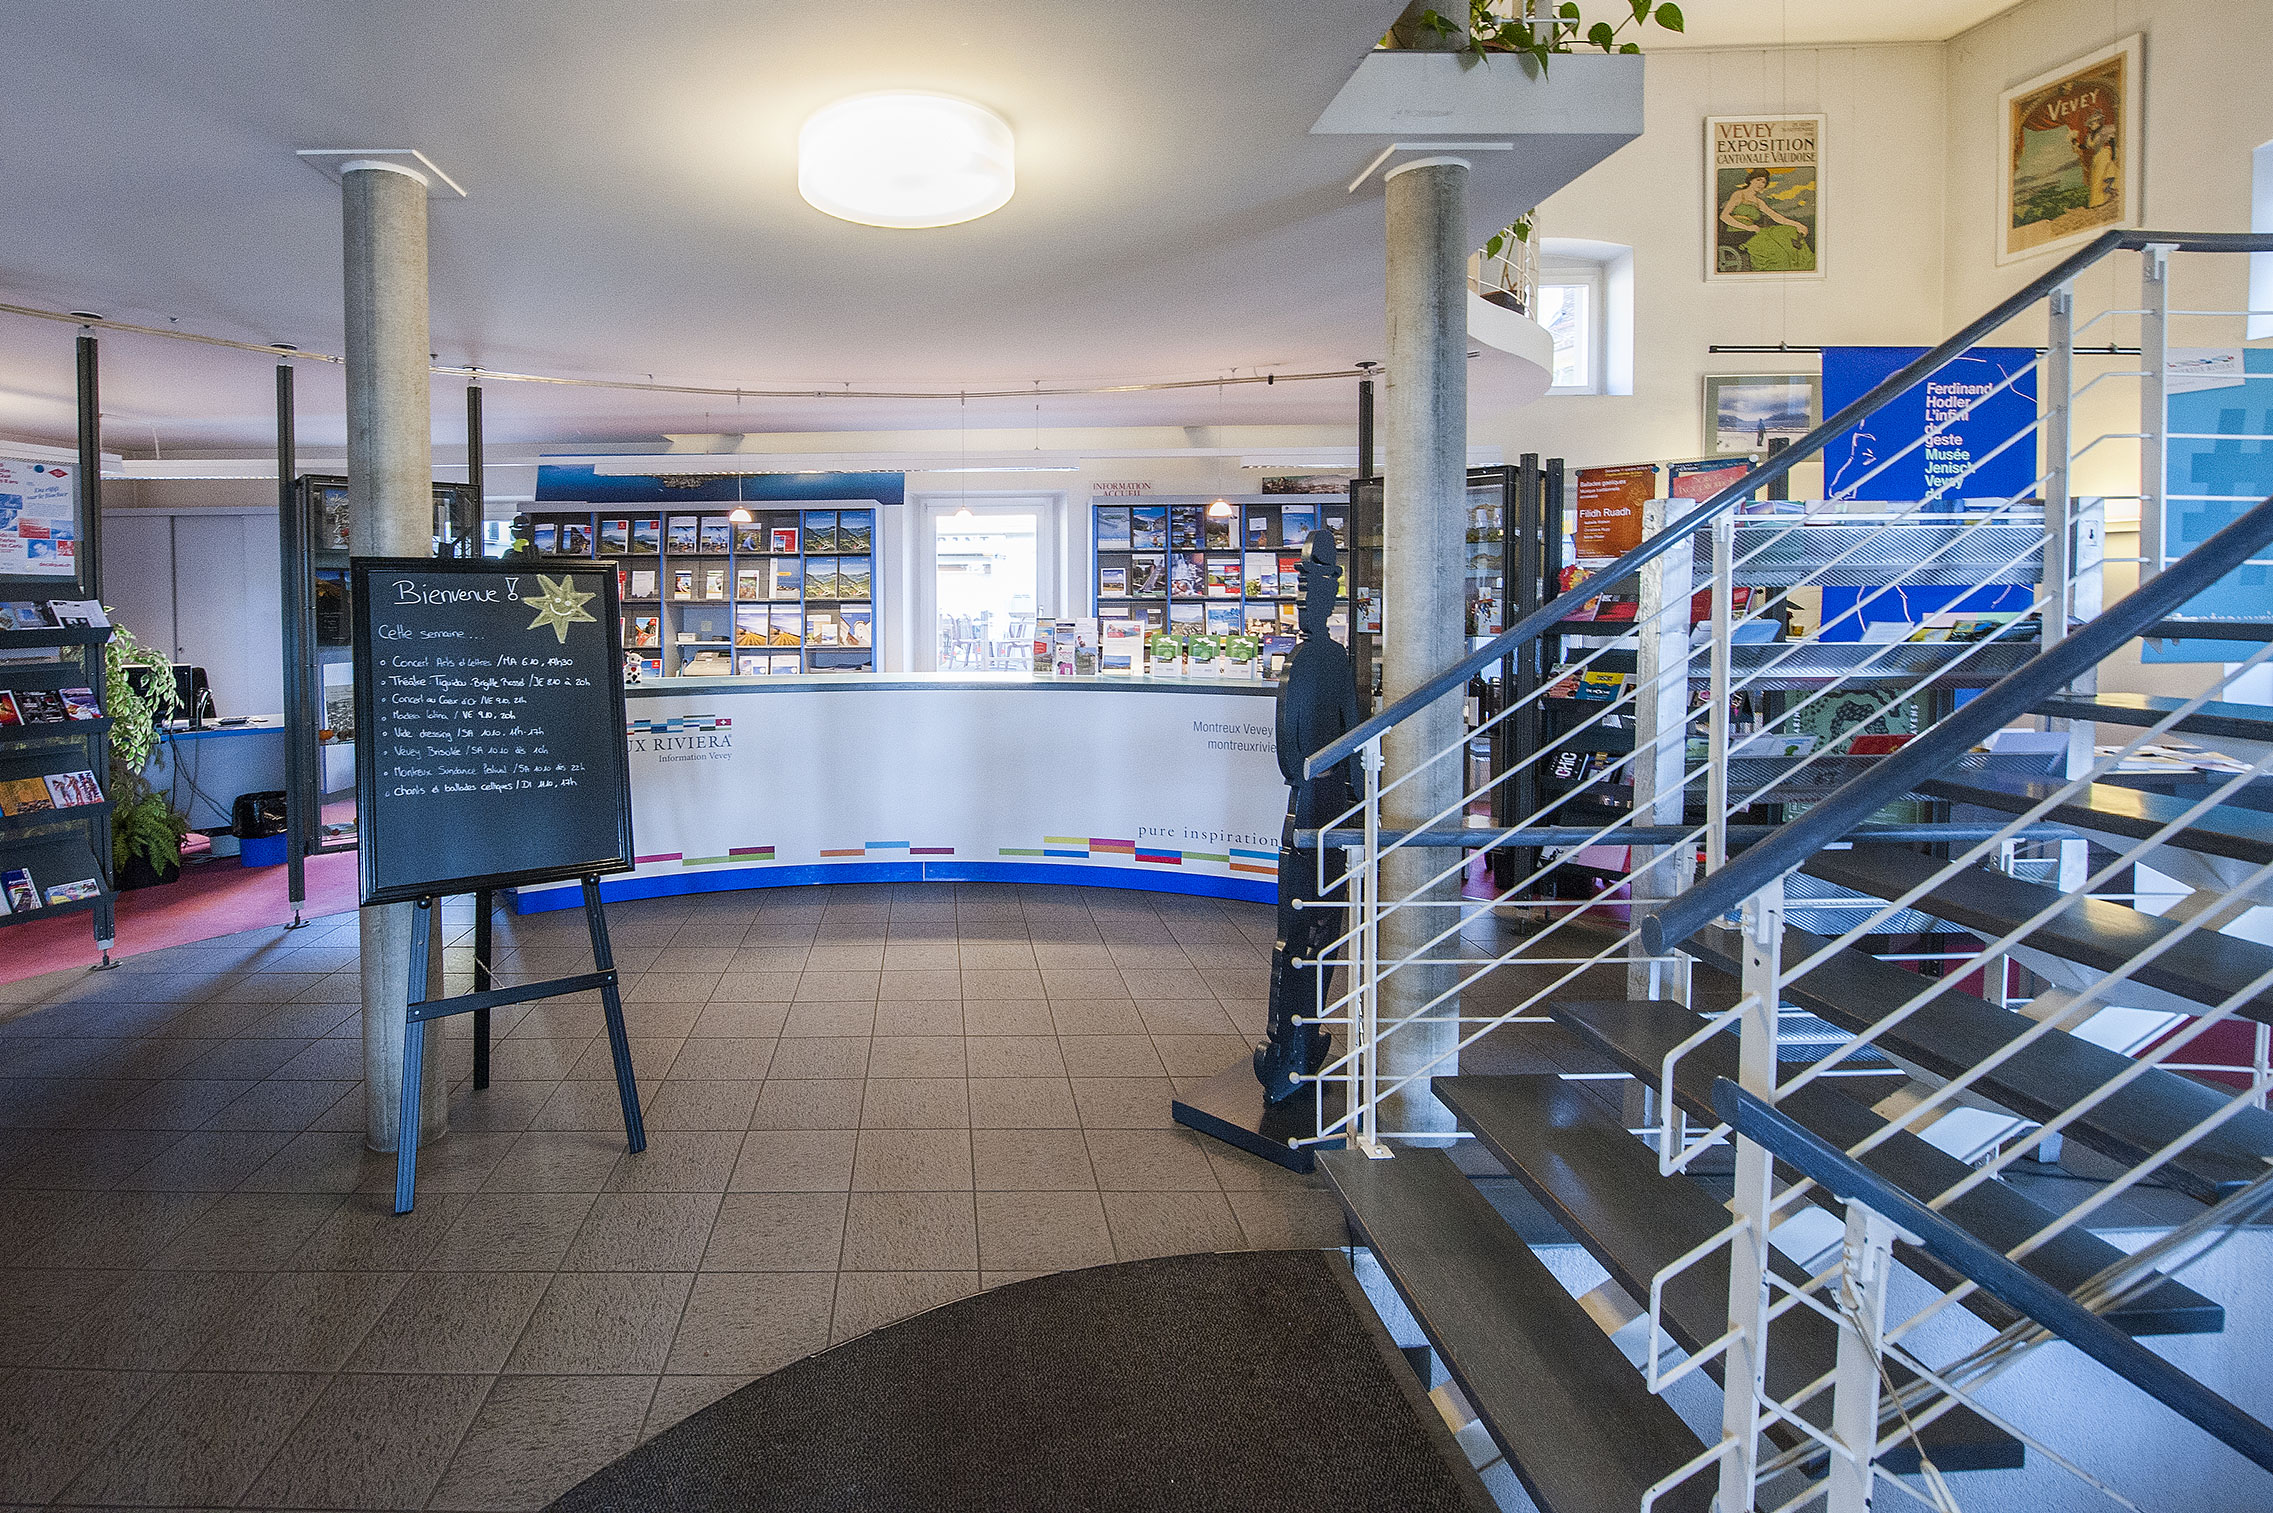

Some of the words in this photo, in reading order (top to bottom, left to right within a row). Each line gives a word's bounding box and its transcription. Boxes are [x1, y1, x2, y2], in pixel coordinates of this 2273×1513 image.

[2047, 88, 2100, 121] VEVEY
[1720, 123, 1776, 139] VEVEY
[1717, 138, 1815, 152] EXPOSITION
[1717, 153, 1770, 164] CANTONALE
[1771, 152, 1816, 163] VAUDOISE
[1926, 382, 1993, 395] Ferdinand
[1925, 396, 1971, 408] Hodler
[1924, 422, 1942, 434] d
[1924, 434, 1963, 448] geste
[1925, 448, 1970, 460] Musée
[1093, 482, 1151, 490] INFORMATION
[1924, 474, 1964, 490] Vevy
[392, 580, 500, 604] Bienvenue
[378, 624, 412, 640] Cette
[392, 656, 429, 668] Concert
[575, 678, 590, 686] 20h
[392, 693, 424, 704] Concert
[500, 710, 516, 720] 20h
[420, 729, 452, 742] dressing
[1193, 721, 1240, 734] Montreux
[1243, 724, 1274, 738] Vevey
[394, 744, 421, 760] Vevey
[532, 745, 548, 754] 10h
[1208, 740, 1276, 753] montreuxrivie
[659, 754, 706, 762] Information
[709, 752, 732, 760] Vevey
[394, 766, 432, 777] Montreux
[438, 766, 477, 776] Sundance
[570, 762, 586, 772] 22h
[444, 782, 477, 792] ballades
[480, 782, 513, 794] celtiques
[560, 777, 578, 786] 17h
[1138, 826, 1175, 838] pure
[1184, 826, 1279, 846] inspiration
